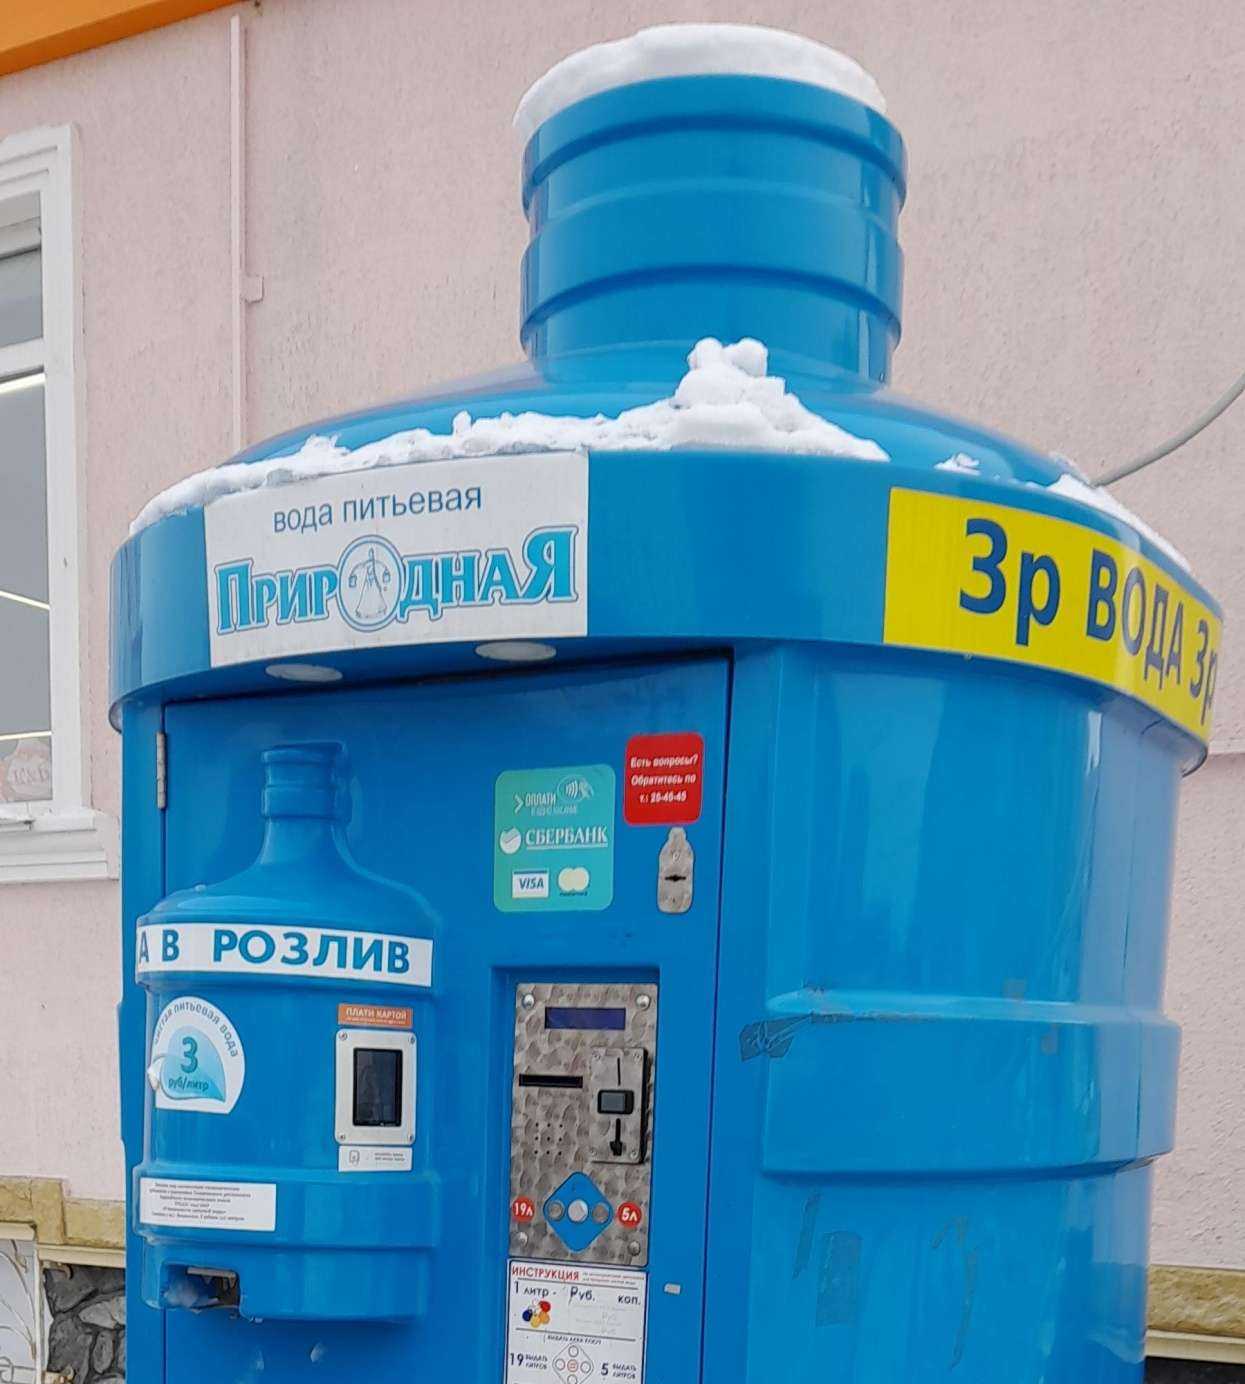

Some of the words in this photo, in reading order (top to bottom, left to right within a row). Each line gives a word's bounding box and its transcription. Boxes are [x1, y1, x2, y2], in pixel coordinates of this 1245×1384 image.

[273, 503, 334, 534] вода
[343, 486, 483, 524] питьевая
[1085, 547, 1185, 691] ВОДА
[630, 756, 652, 769] Есть
[525, 826, 609, 847] СБЕРБАНК
[519, 877, 545, 890] VISA
[161, 928, 180, 962] В
[212, 928, 411, 975] РОЗЛИВ
[345, 1007, 375, 1018] ПЛАТИ
[173, 1001, 220, 1024] питьевая
[219, 1024, 240, 1058] вода
[180, 1036, 199, 1074] 3
[514, 1203, 533, 1216] 19л
[621, 1208, 637, 1221] 5л
[512, 1266, 579, 1280] ИНСТРУКЦИЯ
[513, 1281, 519, 1294] 1
[523, 1287, 549, 1298] литр
[617, 1294, 641, 1305] коп.
[509, 1353, 524, 1366] 19
[600, 1362, 609, 1376] 5
